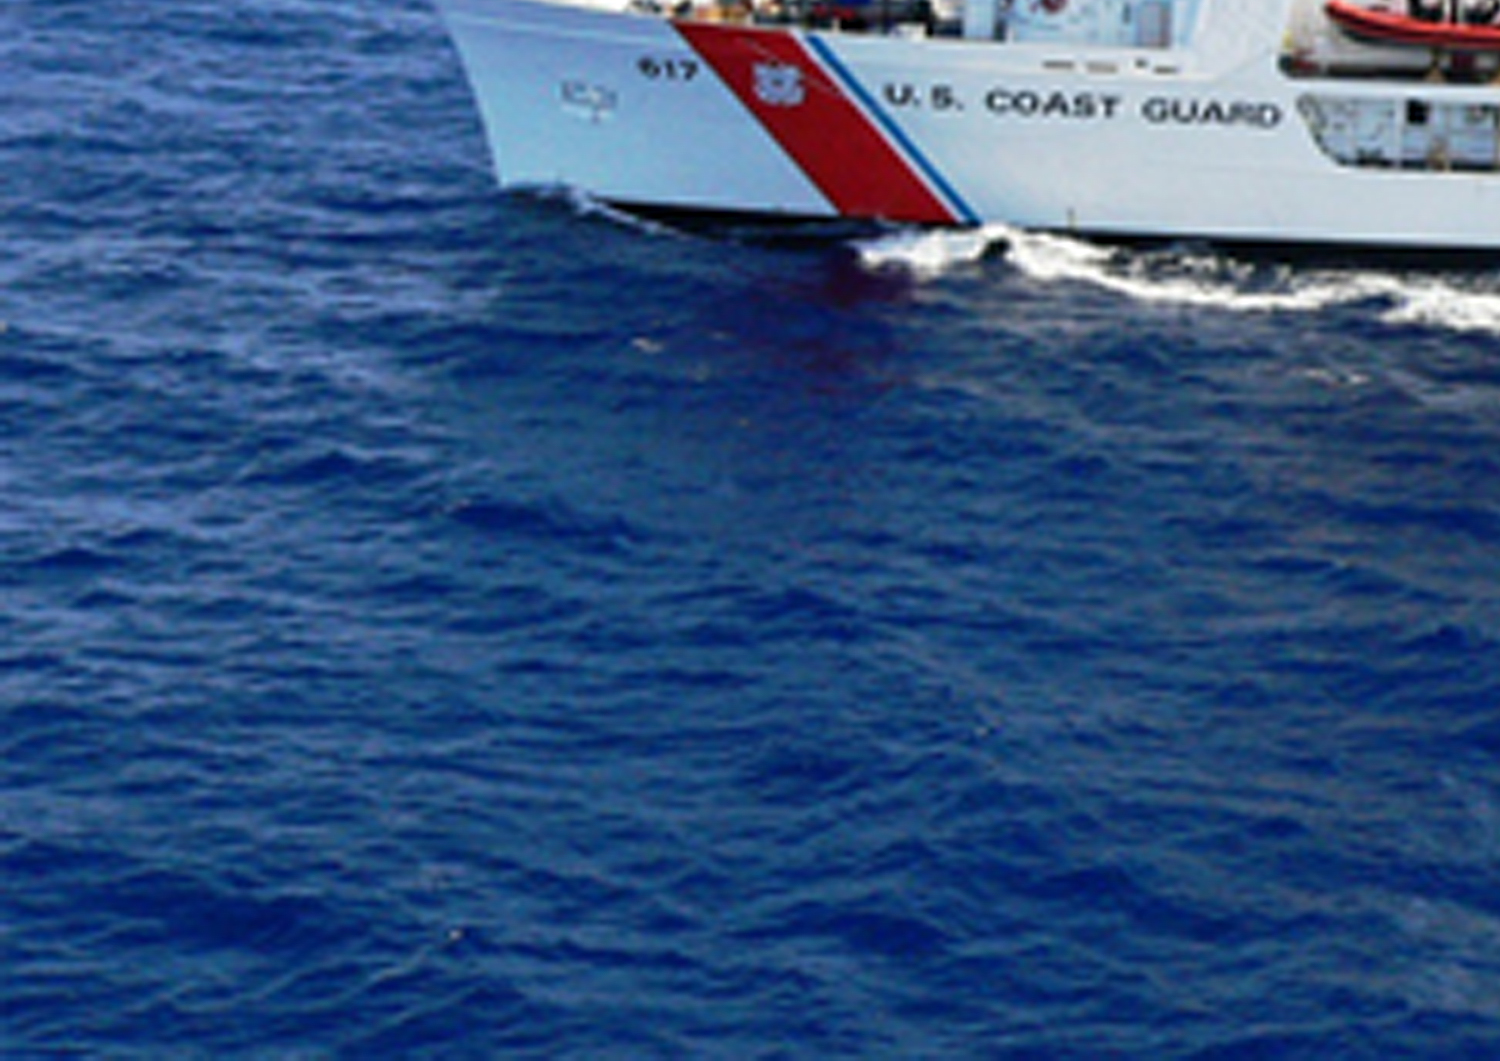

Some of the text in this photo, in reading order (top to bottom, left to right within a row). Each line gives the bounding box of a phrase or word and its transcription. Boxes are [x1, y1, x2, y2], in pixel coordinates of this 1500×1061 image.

[636, 56, 699, 82] 617
[984, 89, 1120, 120] COAST
[1140, 96, 1281, 128] GUARD
